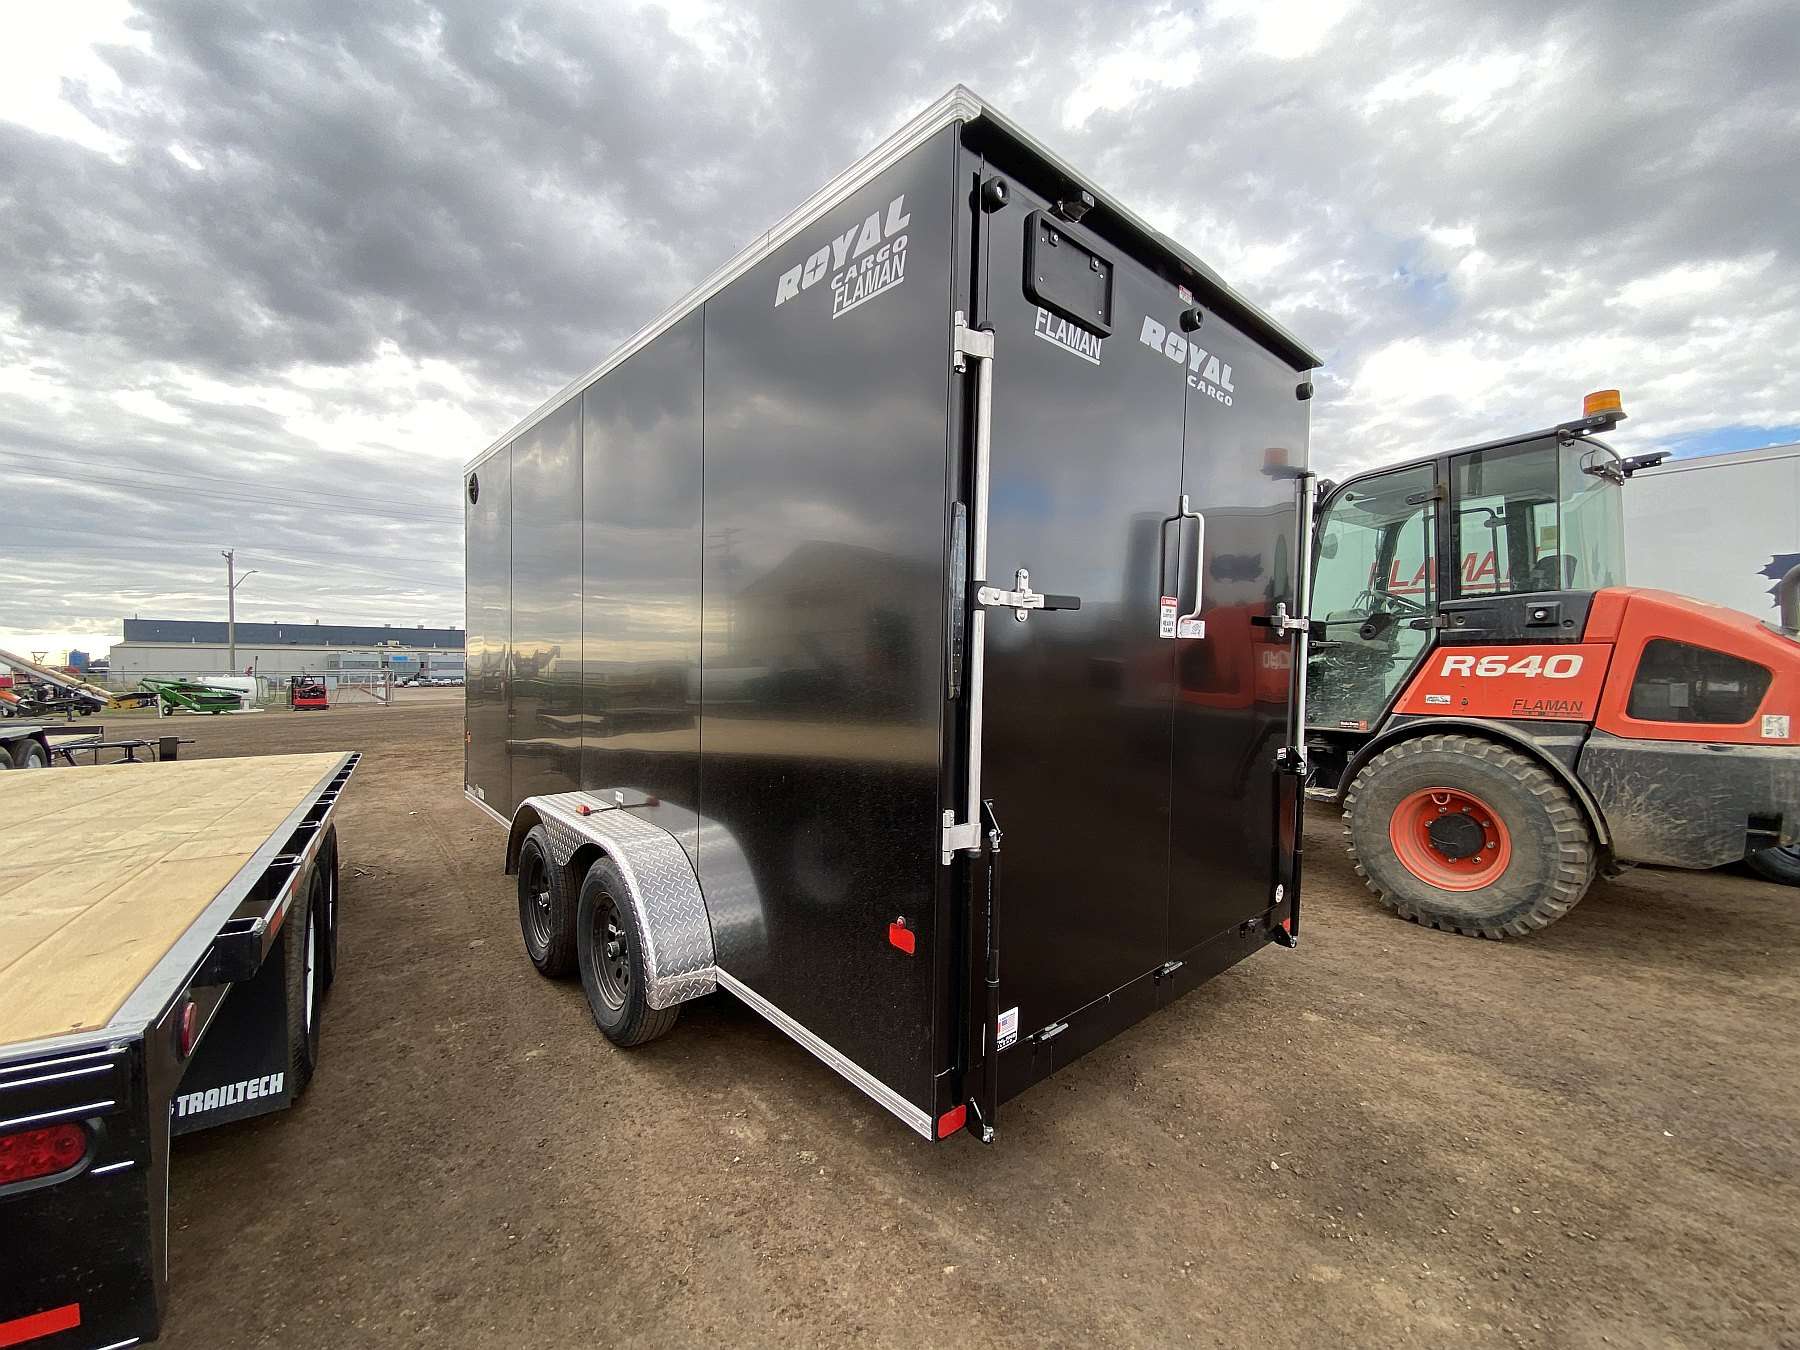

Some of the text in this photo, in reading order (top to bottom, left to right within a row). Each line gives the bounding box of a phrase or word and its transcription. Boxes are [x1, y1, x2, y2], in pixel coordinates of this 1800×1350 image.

[775, 194, 911, 308] ROYAL
[831, 235, 908, 290] CARGO
[832, 250, 907, 315] FLAMAN
[1035, 306, 1103, 360] FLAMAN
[1139, 315, 1235, 393] ROYAL
[1187, 375, 1234, 408] CARGO
[1440, 654, 1584, 679] R640
[1512, 698, 1584, 712] FLAMAN
[177, 1071, 285, 1117] TRAILTECH
